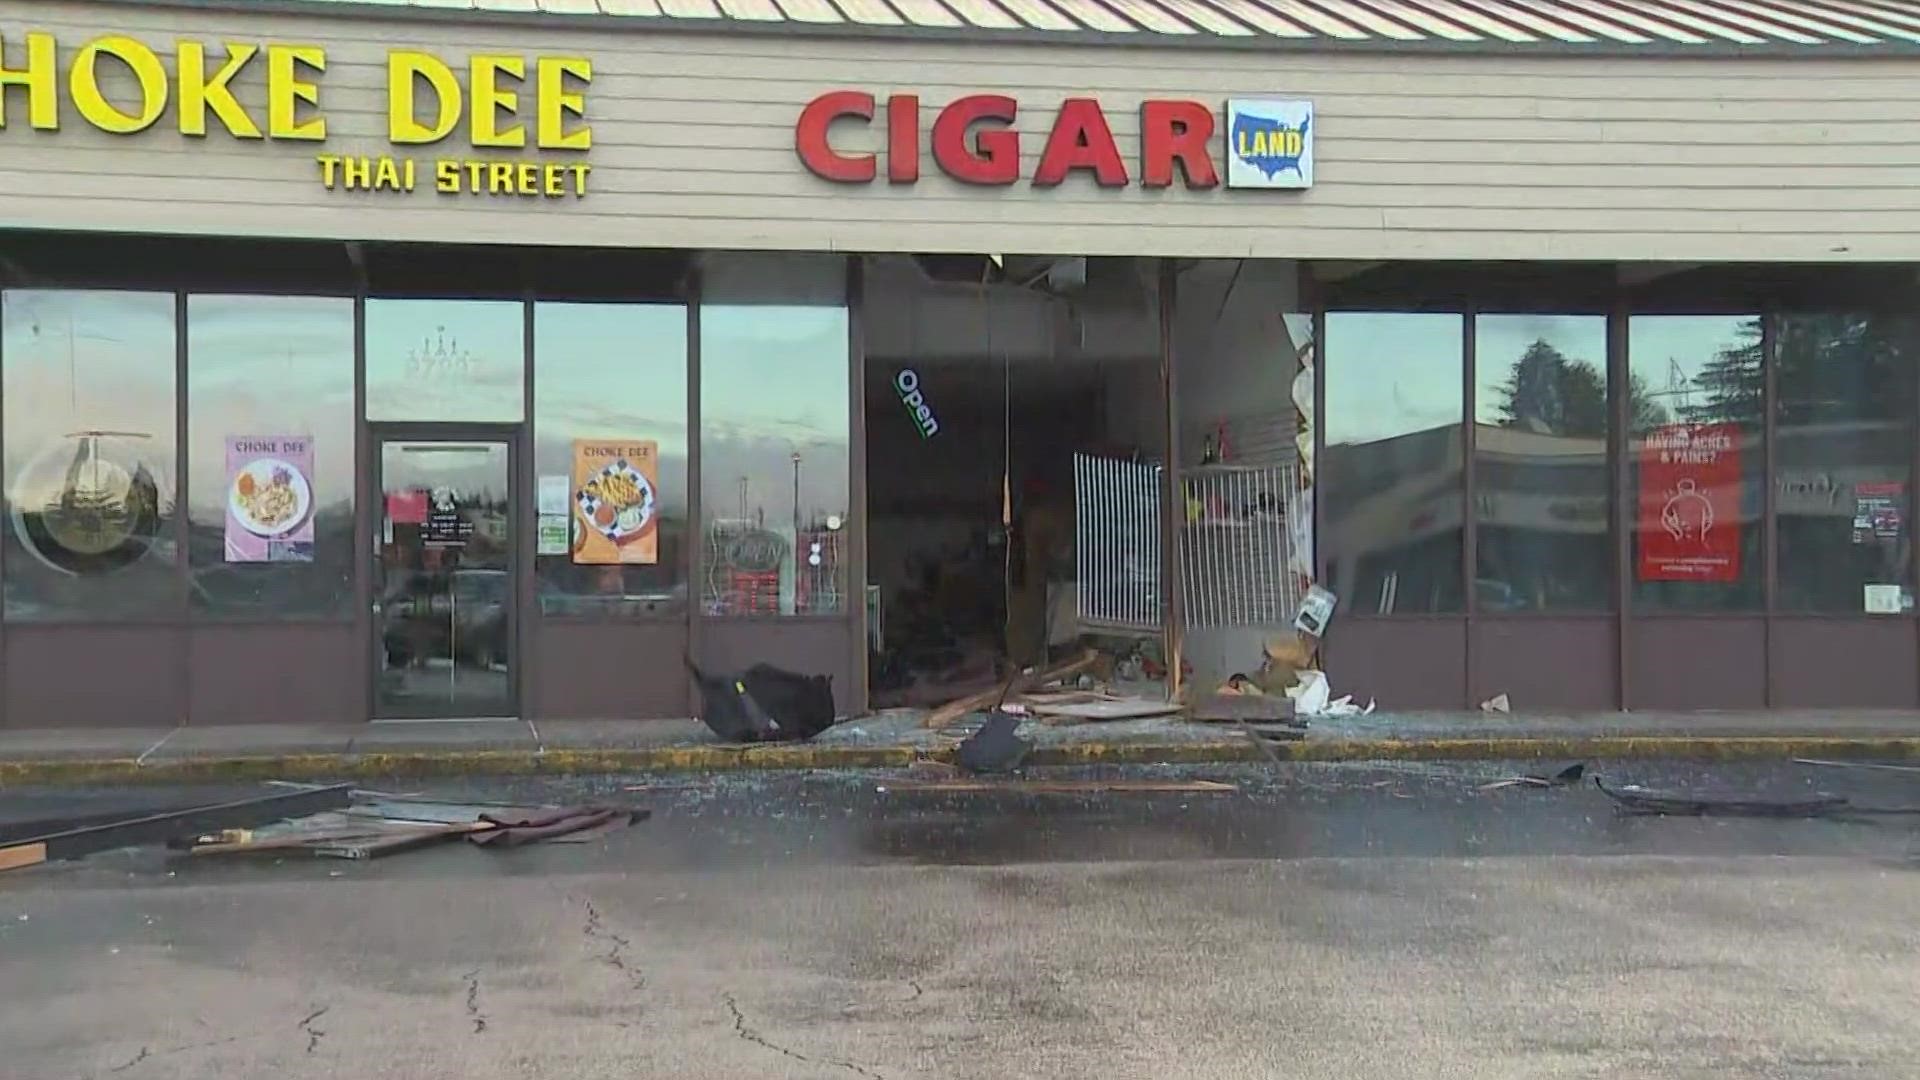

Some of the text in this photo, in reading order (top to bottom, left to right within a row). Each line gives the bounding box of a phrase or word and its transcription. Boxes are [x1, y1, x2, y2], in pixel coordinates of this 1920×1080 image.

[388, 51, 592, 149] DEE
[795, 91, 1303, 188] CIGAR LAND
[318, 155, 592, 196] THAI STREET
[898, 369, 939, 437] Open
[235, 441, 305, 453] CHOKE DEE
[583, 447, 649, 458] CHOKE DEE
